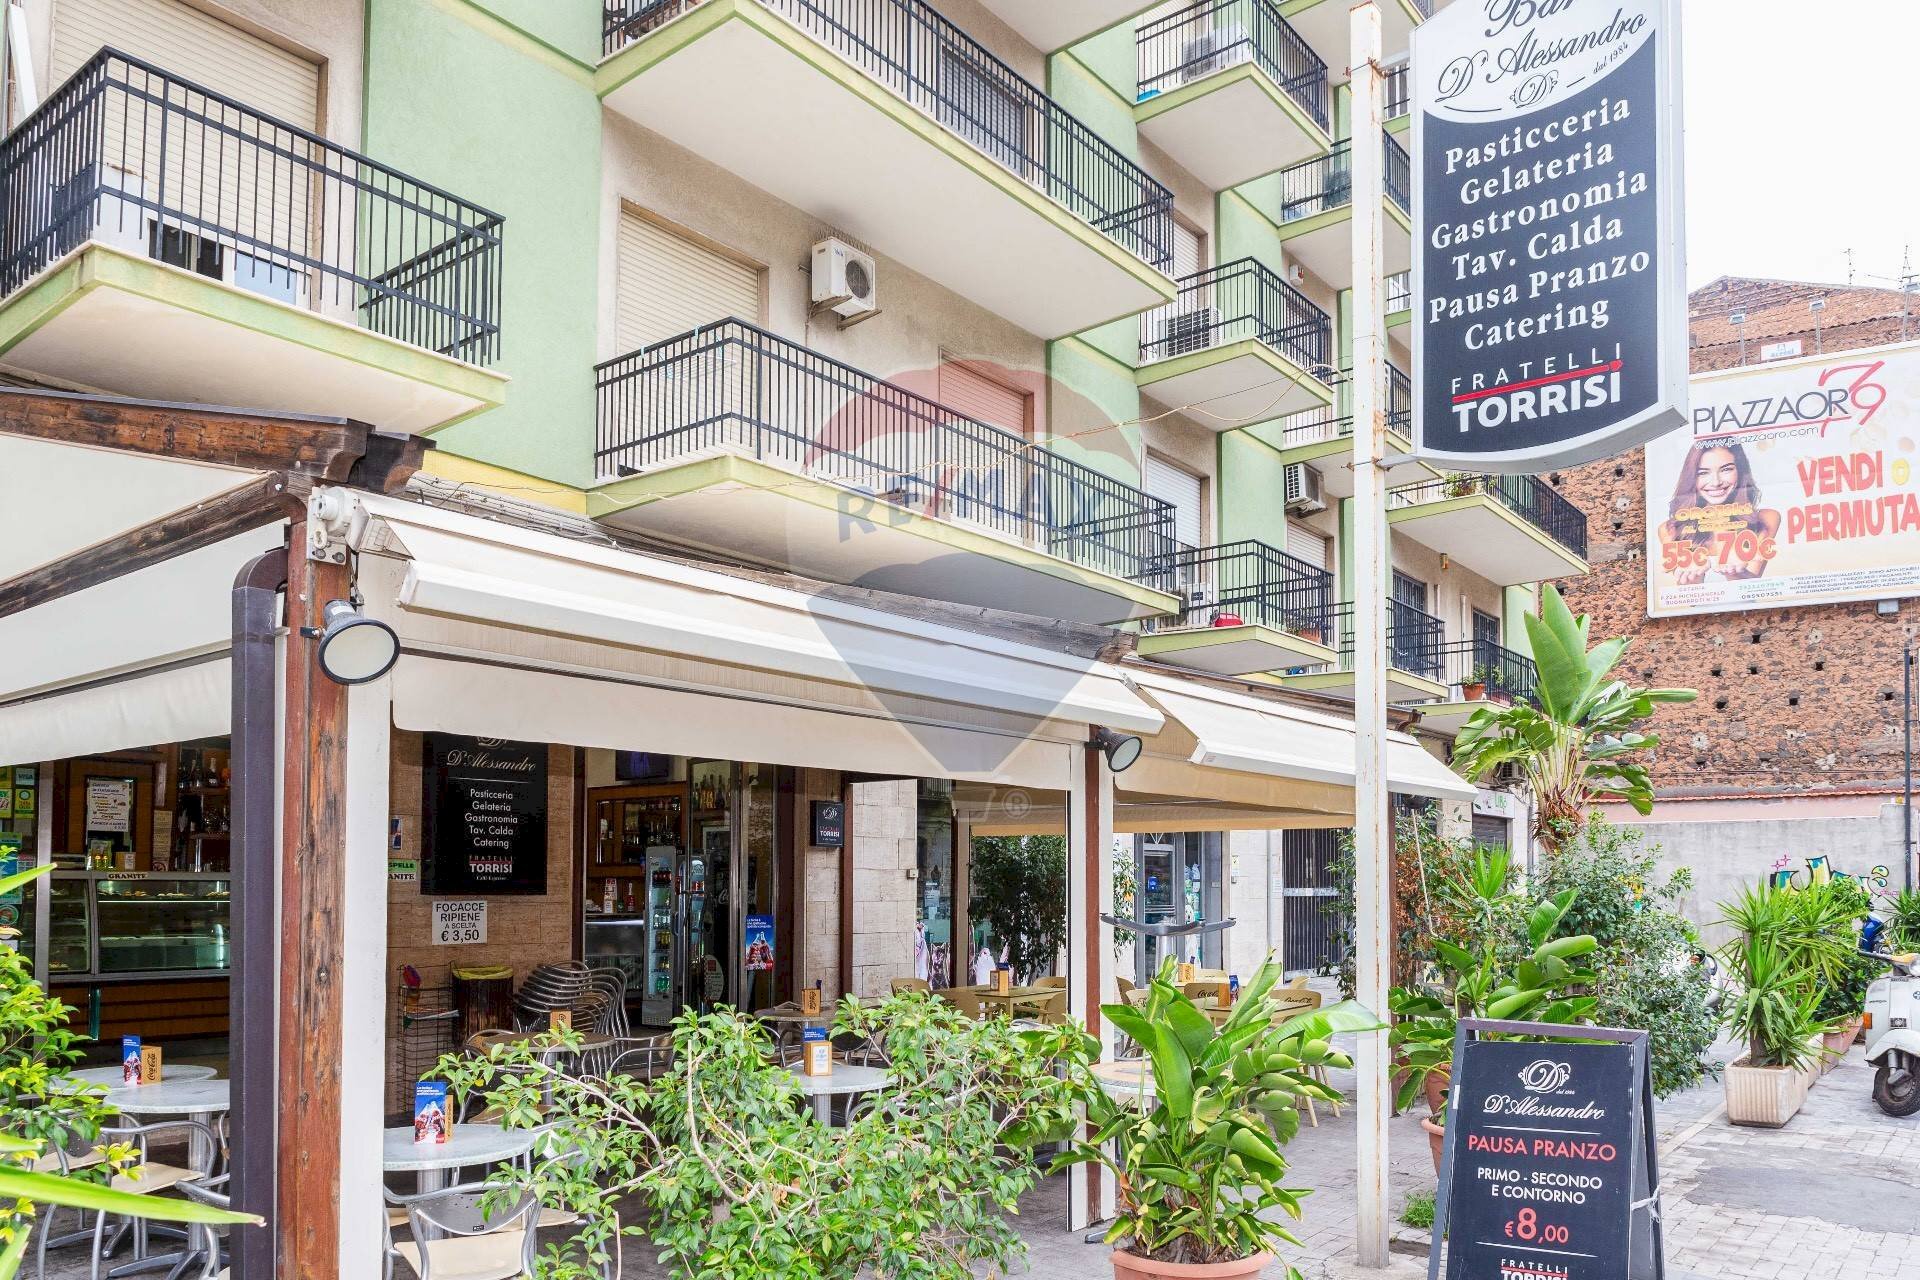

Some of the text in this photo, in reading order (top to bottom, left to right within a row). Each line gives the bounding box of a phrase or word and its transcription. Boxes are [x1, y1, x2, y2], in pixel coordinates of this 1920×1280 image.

[1445, 97, 1631, 175] Pasticceria
[1461, 141, 1614, 205] Gelateria
[1431, 170, 1648, 249] Gastronomia
[1452, 214, 1624, 281] Tav. Calda
[1429, 251, 1650, 323] Pausa Pranzo
[1465, 300, 1610, 350] Catering
[1452, 342, 1621, 395] FRATELLI
[1452, 371, 1621, 433] TORRISI
[1797, 451, 1884, 497] VENDI
[1787, 493, 1920, 545] PERMUTA
[470, 788, 513, 800] Pasticceria
[472, 800, 511, 812] Gelateria
[464, 812, 518, 824] Gastronomia
[469, 824, 514, 835] Tav. Calda
[473, 837, 509, 850] Catering
[469, 863, 513, 873] TORRISI
[435, 902, 485, 912] FOCACCE
[440, 912, 481, 922] RIPIENE
[441, 929, 480, 943] € 3,50
[1482, 1094, 1605, 1120] D'Alessandro
[1468, 1134, 1616, 1162] PAUSA PRANZO
[1477, 1167, 1520, 1182] PRIMO
[1531, 1172, 1603, 1190] SECONDO
[1491, 1185, 1586, 1205] E CONTORNO
[1501, 1258, 1568, 1274] FRATELLI
